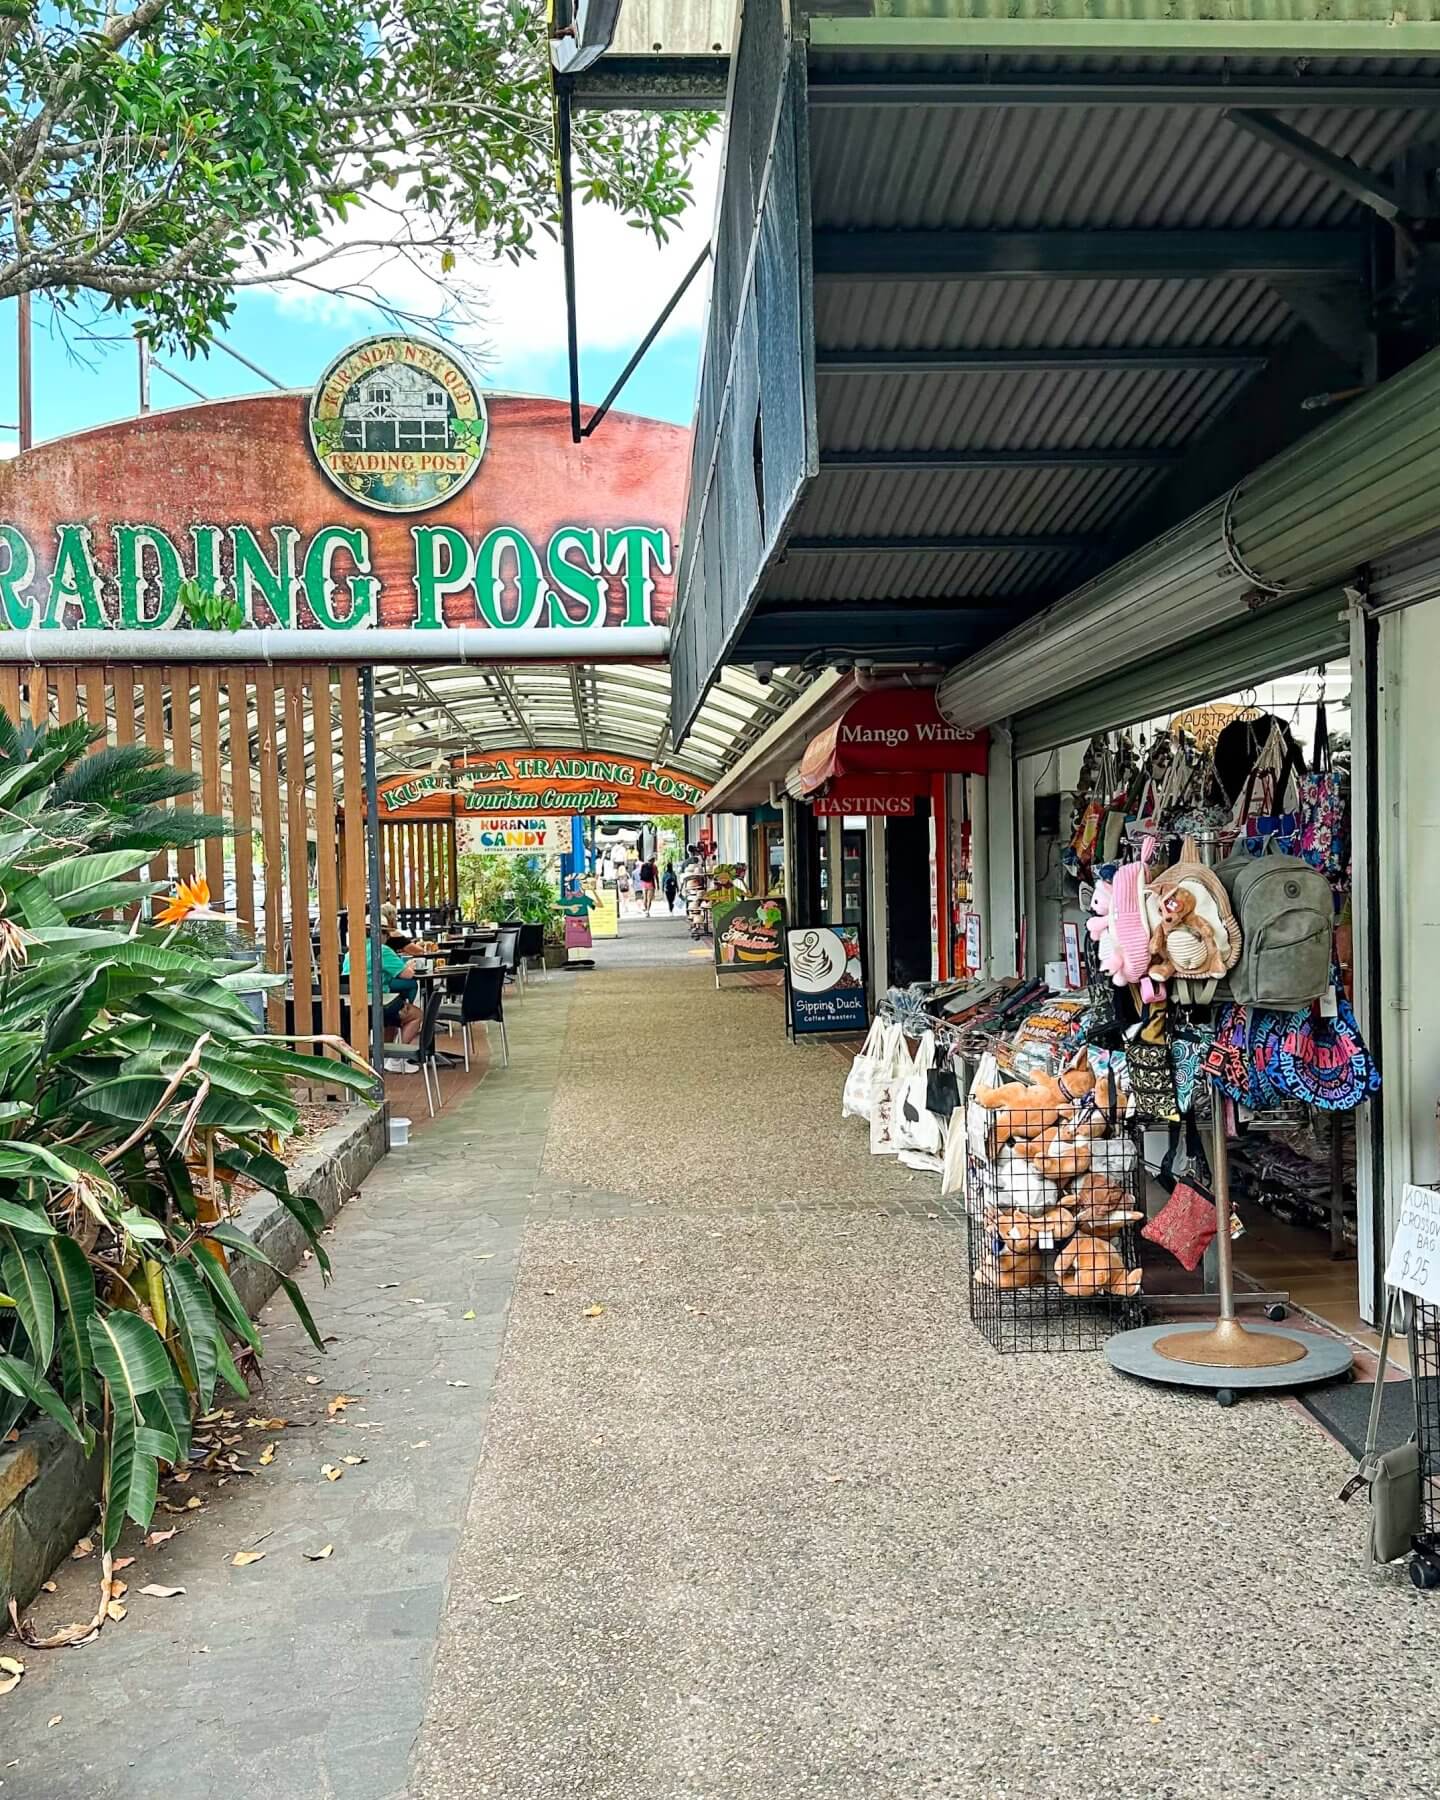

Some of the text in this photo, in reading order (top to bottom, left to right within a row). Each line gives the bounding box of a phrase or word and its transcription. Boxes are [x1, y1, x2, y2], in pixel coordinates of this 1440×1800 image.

[324, 344, 396, 408] KURANDA
[444, 370, 471, 406] QLD
[329, 455, 469, 471] TRADING POST
[411, 524, 672, 630] POST
[841, 722, 976, 748] Mango Wines
[514, 758, 634, 786] TRADING
[637, 768, 705, 806] POST
[464, 788, 619, 813] Tourism Complex
[817, 797, 911, 812] TASTINGS
[480, 819, 547, 831] KURANDA
[480, 831, 547, 847] CANDY
[796, 996, 862, 1015] Sipping Duck
[803, 1013, 857, 1022] Coffee Roasters
[1406, 1190, 1440, 1216] KOAL
[1417, 1233, 1435, 1252] BAG
